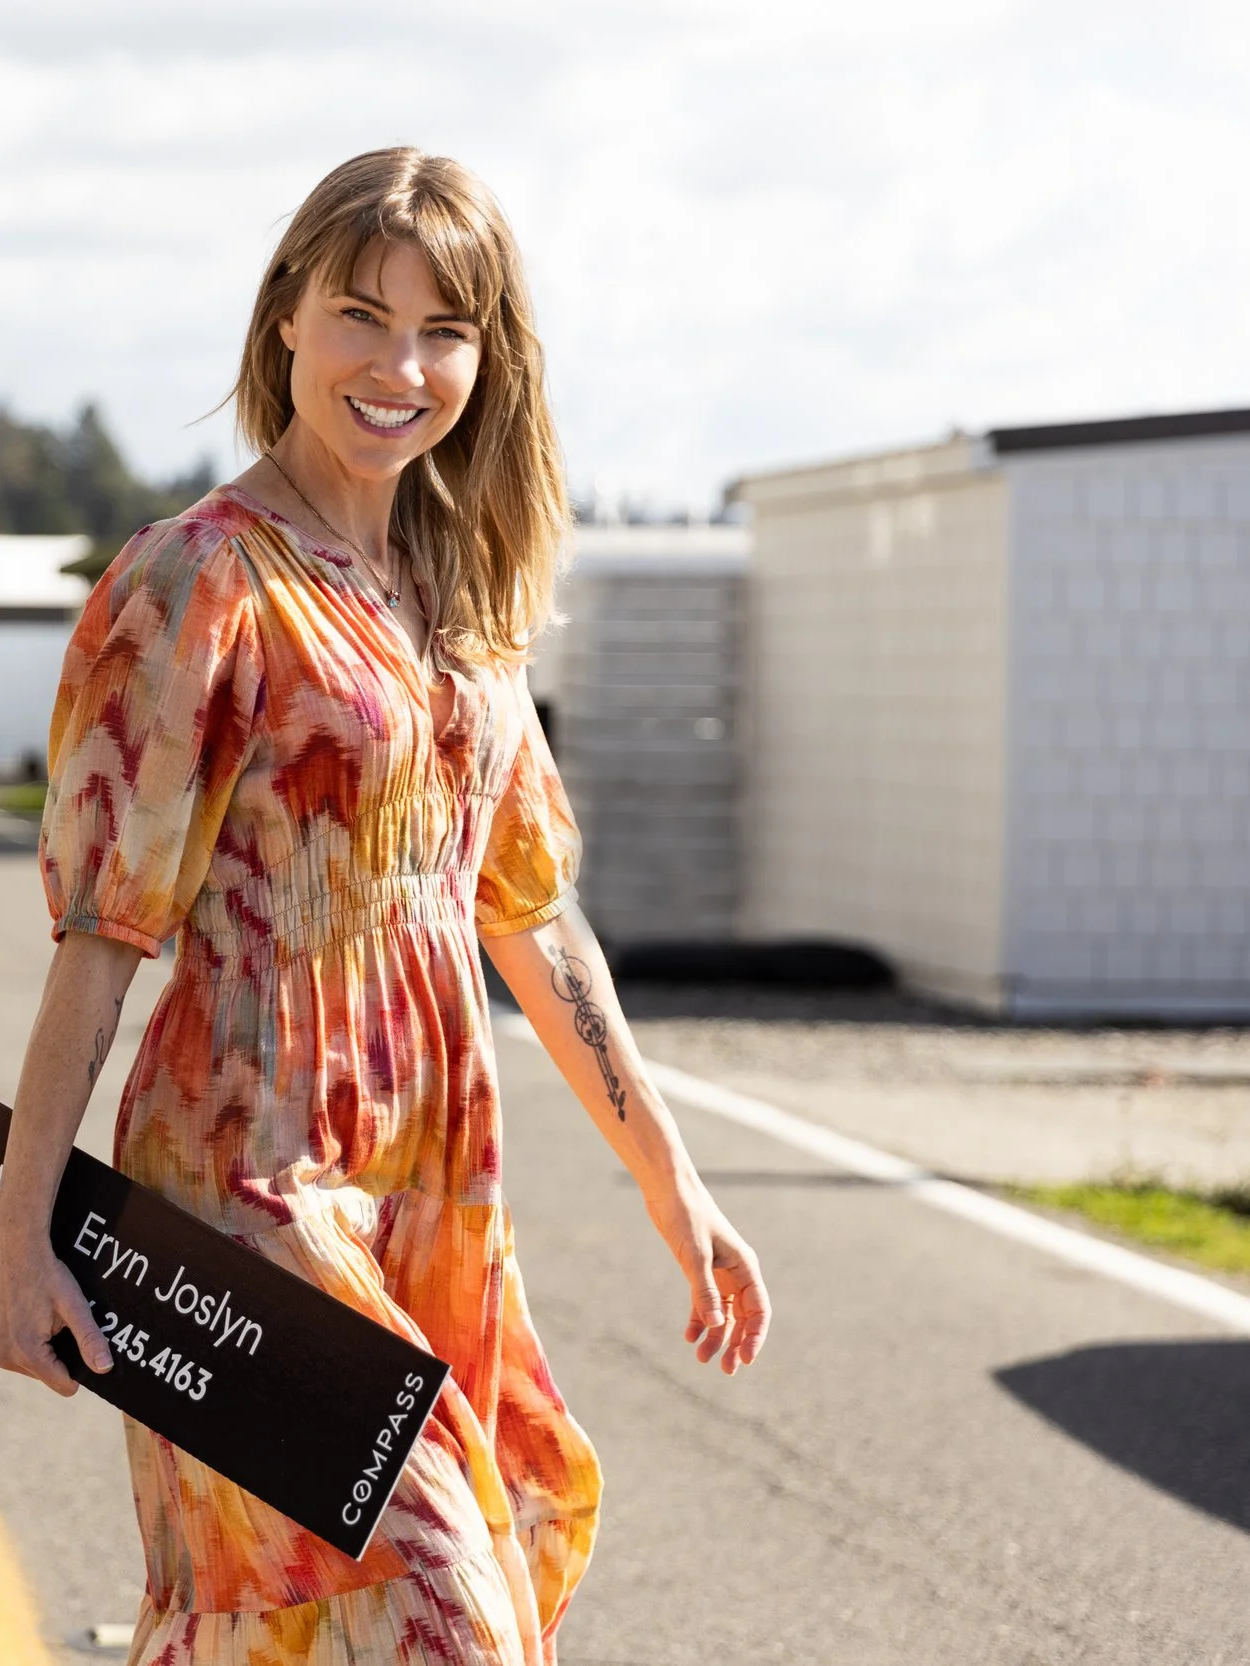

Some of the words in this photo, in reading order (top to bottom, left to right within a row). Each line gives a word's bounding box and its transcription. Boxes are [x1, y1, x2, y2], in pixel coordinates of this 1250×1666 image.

[73, 1211, 149, 1287] Eryn
[154, 1265, 263, 1356] Joslyn
[88, 1299, 214, 1402] 245.4163
[342, 1372, 425, 1525] COMPASS
